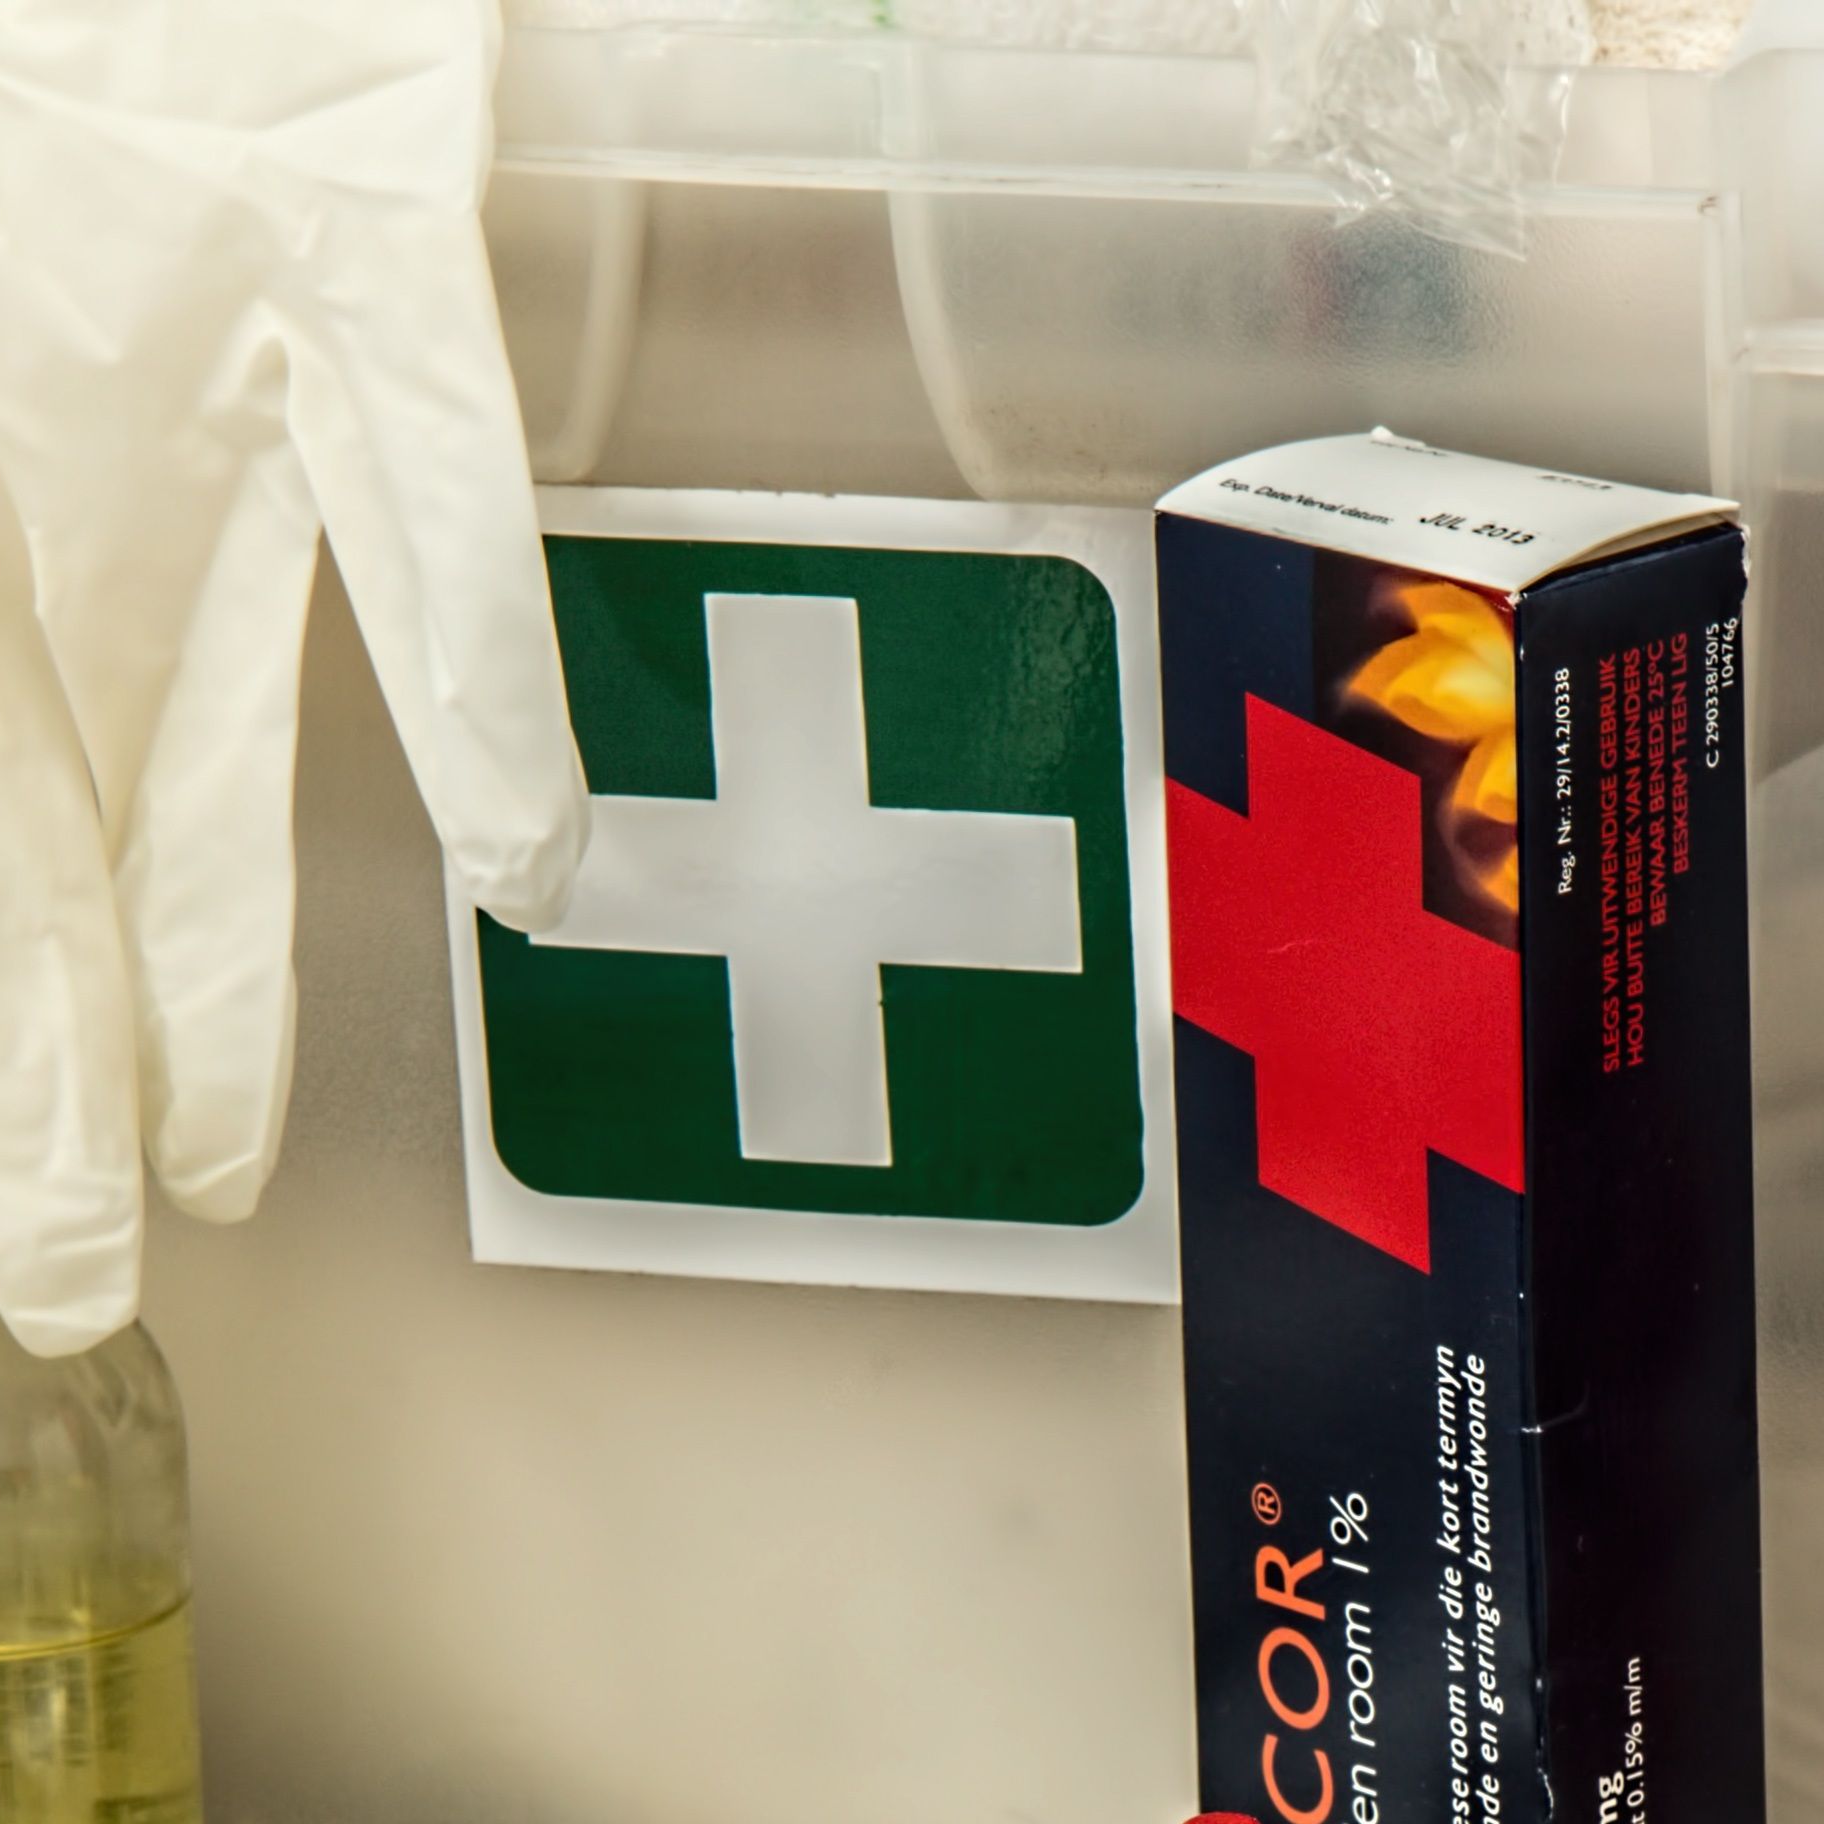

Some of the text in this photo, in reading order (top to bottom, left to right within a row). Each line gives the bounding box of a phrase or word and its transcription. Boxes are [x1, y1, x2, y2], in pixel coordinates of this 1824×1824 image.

[1419, 511, 1537, 546] JUL 2013
[1705, 622, 1720, 769] C 290338/50/5
[1721, 617, 1738, 688] 104766
[1555, 667, 1577, 895] Reg. Nr.: 29/14.2/0338
[1648, 707, 1666, 813] BENEDE
[1671, 632, 1690, 874] BESKERM TEEN LIG
[1599, 653, 1621, 1074] SLEGS VIR UITWENDIGE GEBRUIK
[1623, 647, 1645, 1067] HOU BUITE BEREIK VAN KINDERS
[1649, 815, 1667, 927] BEWAAR
[1436, 1345, 1466, 1674] vir die kort termyn
[1460, 1353, 1491, 1573] brandwonde
[1344, 1601, 1376, 1749] room
[1472, 1582, 1505, 1716] geringe
[1480, 1722, 1499, 1764] en
[1622, 1656, 1644, 1806] 0.15% m/m
